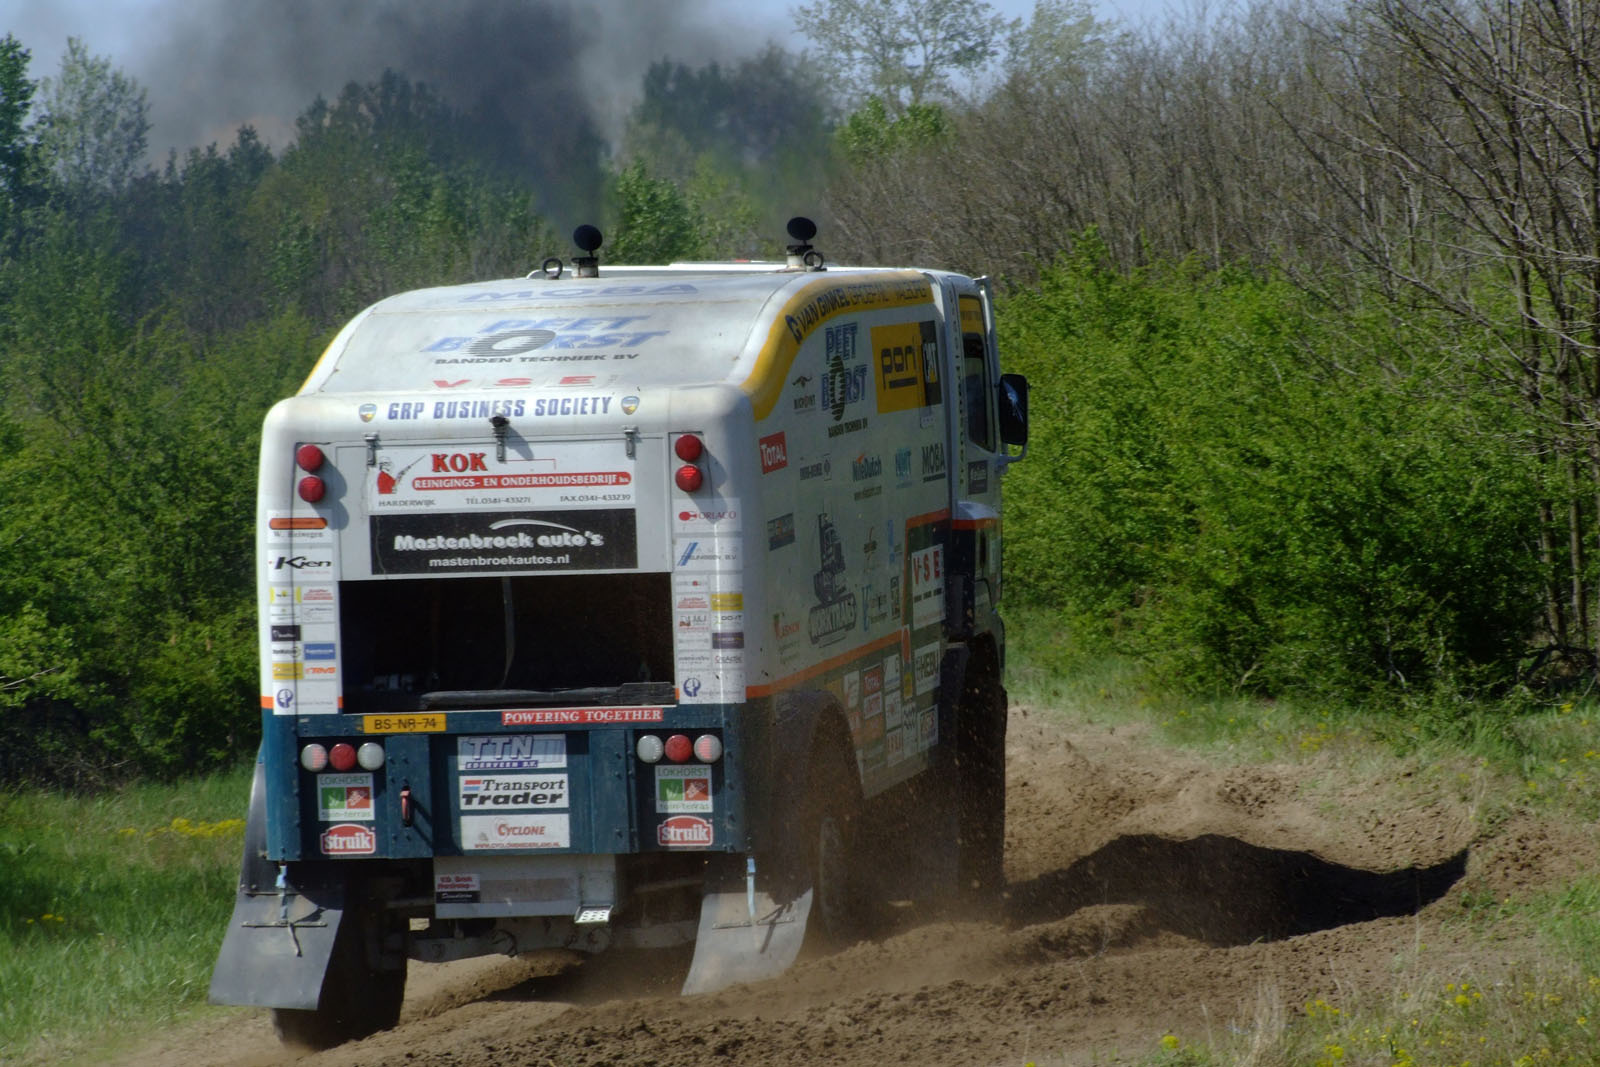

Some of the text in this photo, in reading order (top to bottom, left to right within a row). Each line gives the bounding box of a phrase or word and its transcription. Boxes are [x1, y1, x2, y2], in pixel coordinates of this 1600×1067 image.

[460, 284, 699, 302] MOBA
[797, 303, 820, 331] VAN
[816, 287, 850, 316] GINKEL
[479, 315, 651, 332] PEET
[826, 322, 857, 364] PEET
[435, 353, 640, 365] BANDEN TECHNIEK BV
[387, 396, 613, 420] GRP BUSINESS SOCIETY
[431, 452, 489, 473] KOK
[760, 443, 787, 467] TOTAL
[921, 443, 946, 474] MOBA
[414, 478, 480, 490] REINIGINGS-
[483, 477, 499, 487] EN
[501, 474, 617, 487] ONDERHOUDSBEDRIJF
[378, 499, 436, 508] HARDERWIJK
[698, 511, 737, 520] ORLACO
[394, 531, 604, 551] Mastenbroek auto's
[429, 554, 571, 568] mastenbroekautos.nl
[504, 709, 662, 723] POWERING TOGETHER
[468, 736, 535, 761] TTN
[657, 767, 708, 777] LOKHORST
[482, 779, 566, 792] Transport
[462, 792, 563, 806] Trader
